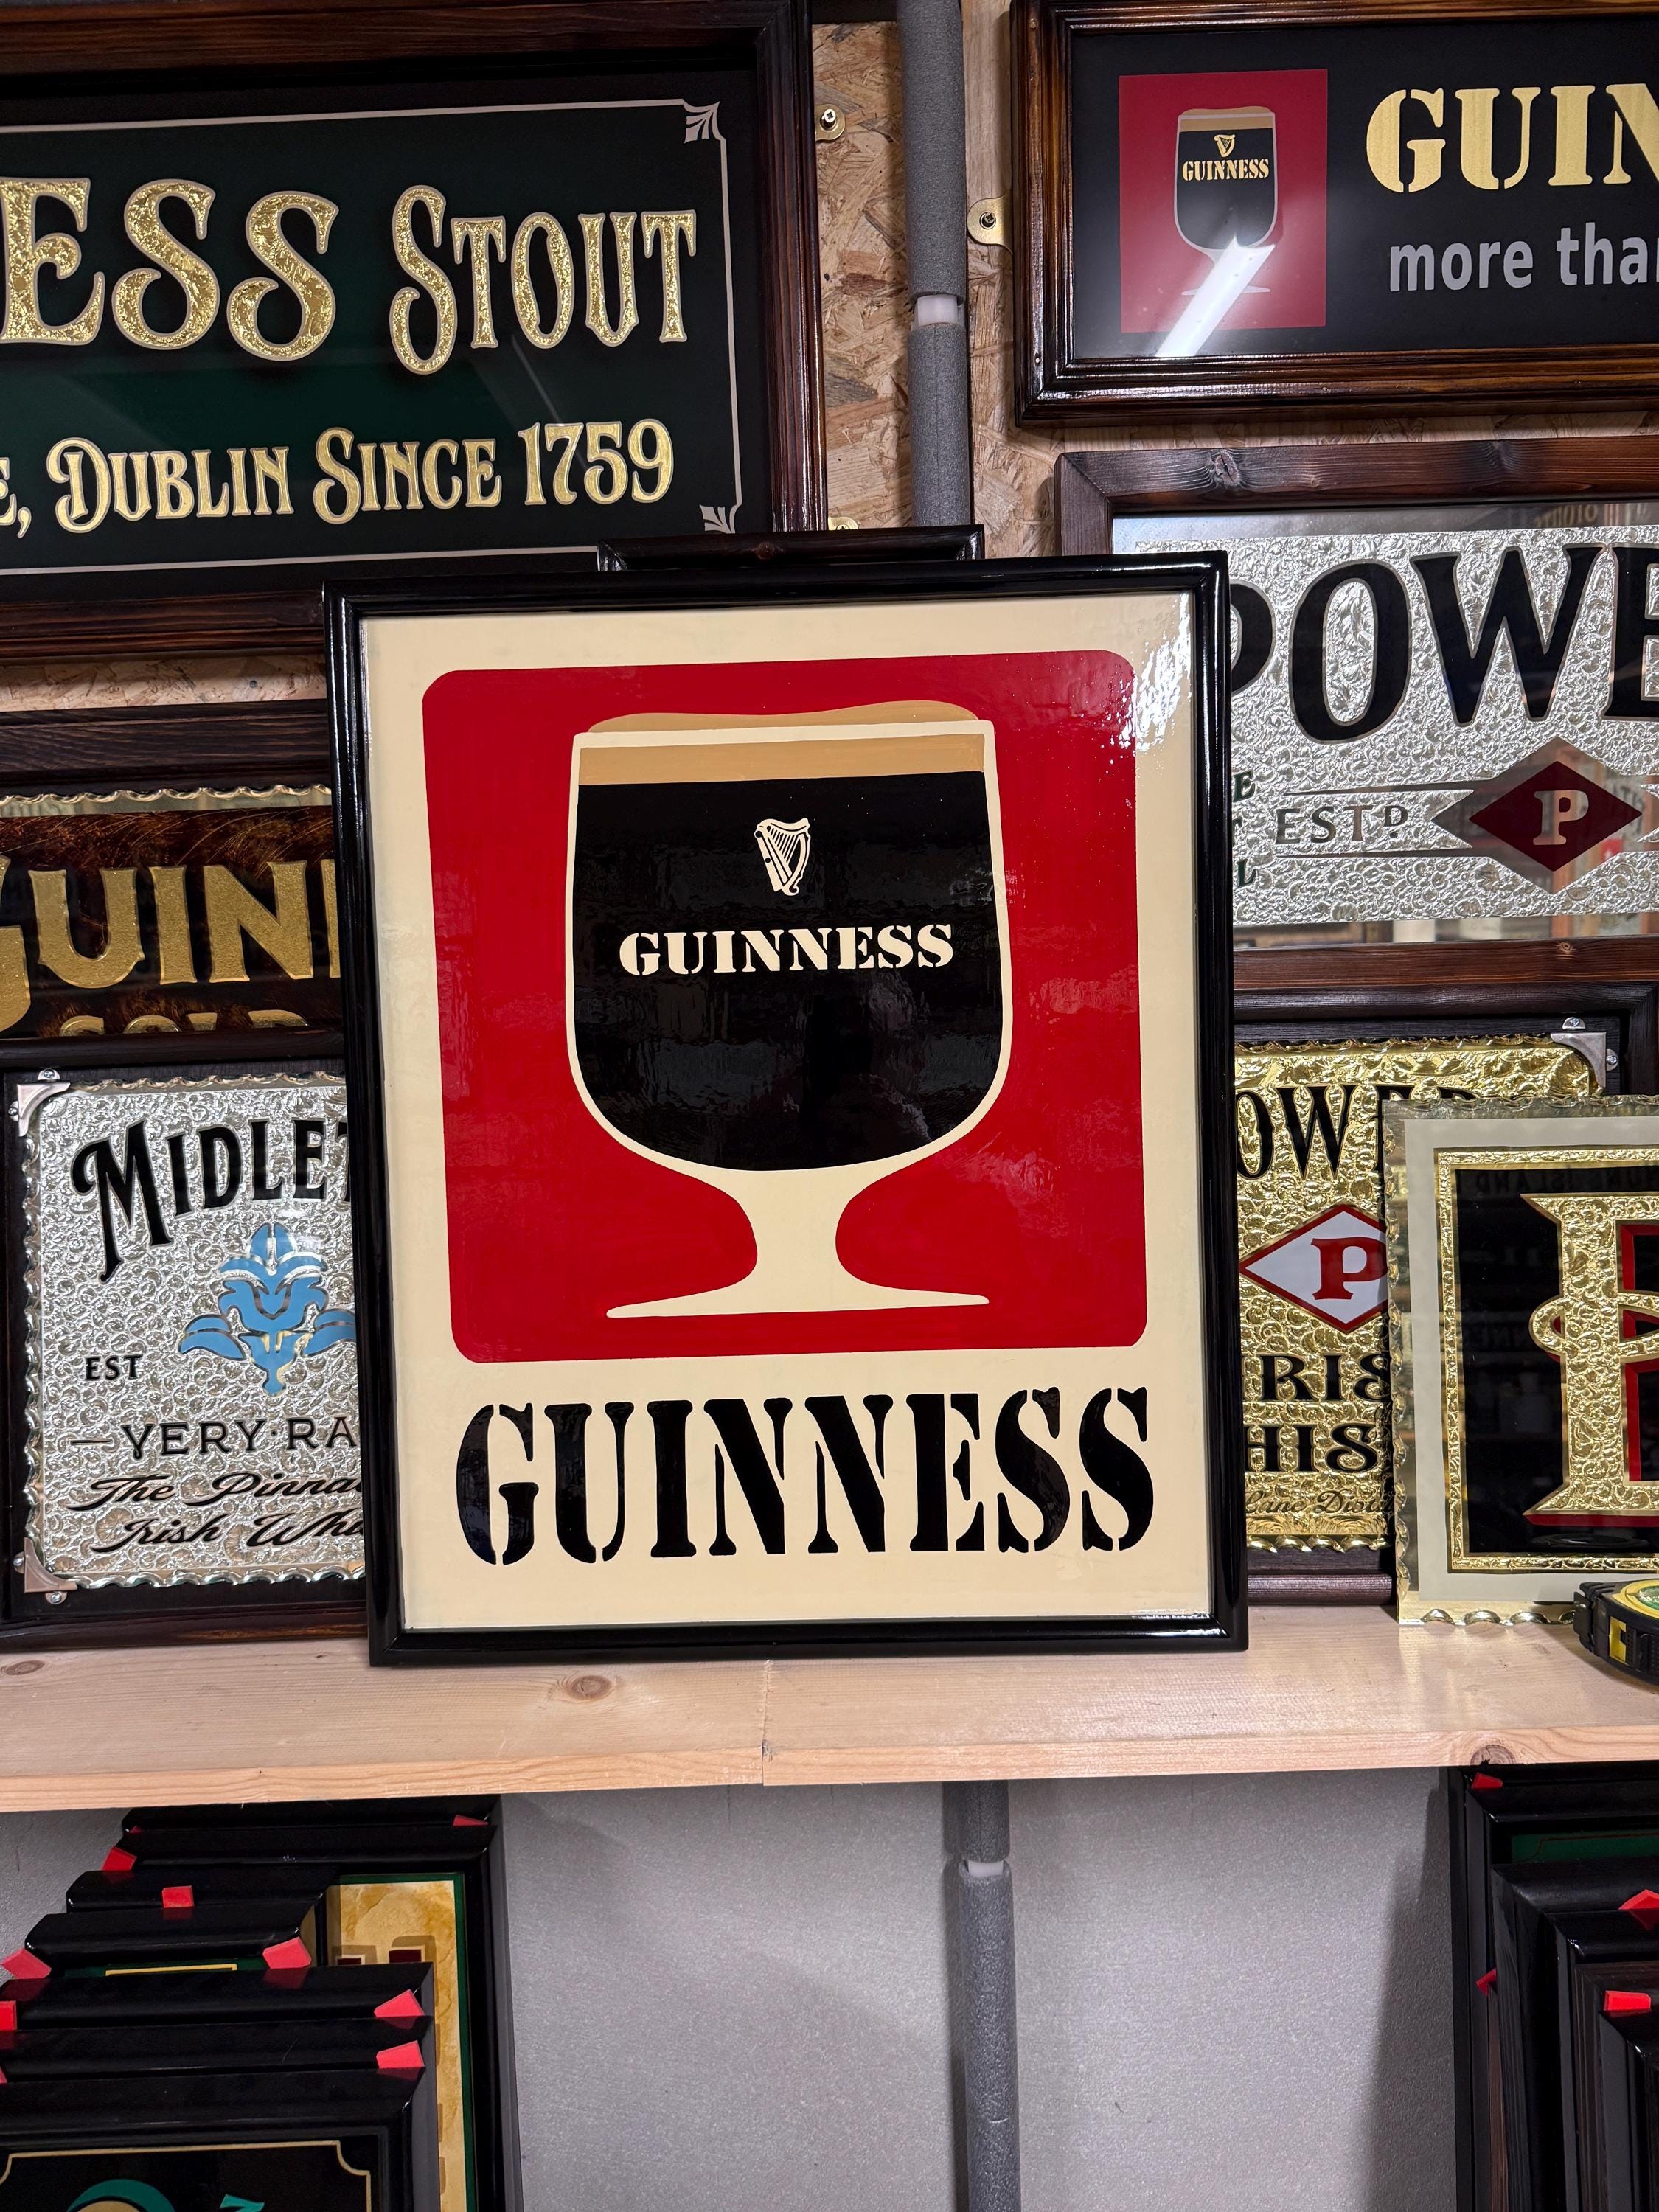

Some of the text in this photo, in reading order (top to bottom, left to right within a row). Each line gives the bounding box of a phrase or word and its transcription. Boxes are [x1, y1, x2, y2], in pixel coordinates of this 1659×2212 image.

[1183, 159, 1270, 181] GUINNESS
[389, 184, 698, 375] STOUT
[1390, 240, 1534, 291] more
[46, 437, 294, 535] DUBLIN
[315, 426, 502, 525] SINCE
[517, 418, 674, 507] 1759
[1533, 790, 1589, 846] P
[619, 923, 953, 976] GUINNESS
[1311, 1237, 1388, 1301] P
[86, 1355, 143, 1381] EST
[122, 1419, 267, 1460] VERY
[68, 1475, 177, 1512] The
[456, 1386, 1155, 1565] GUINNESS
